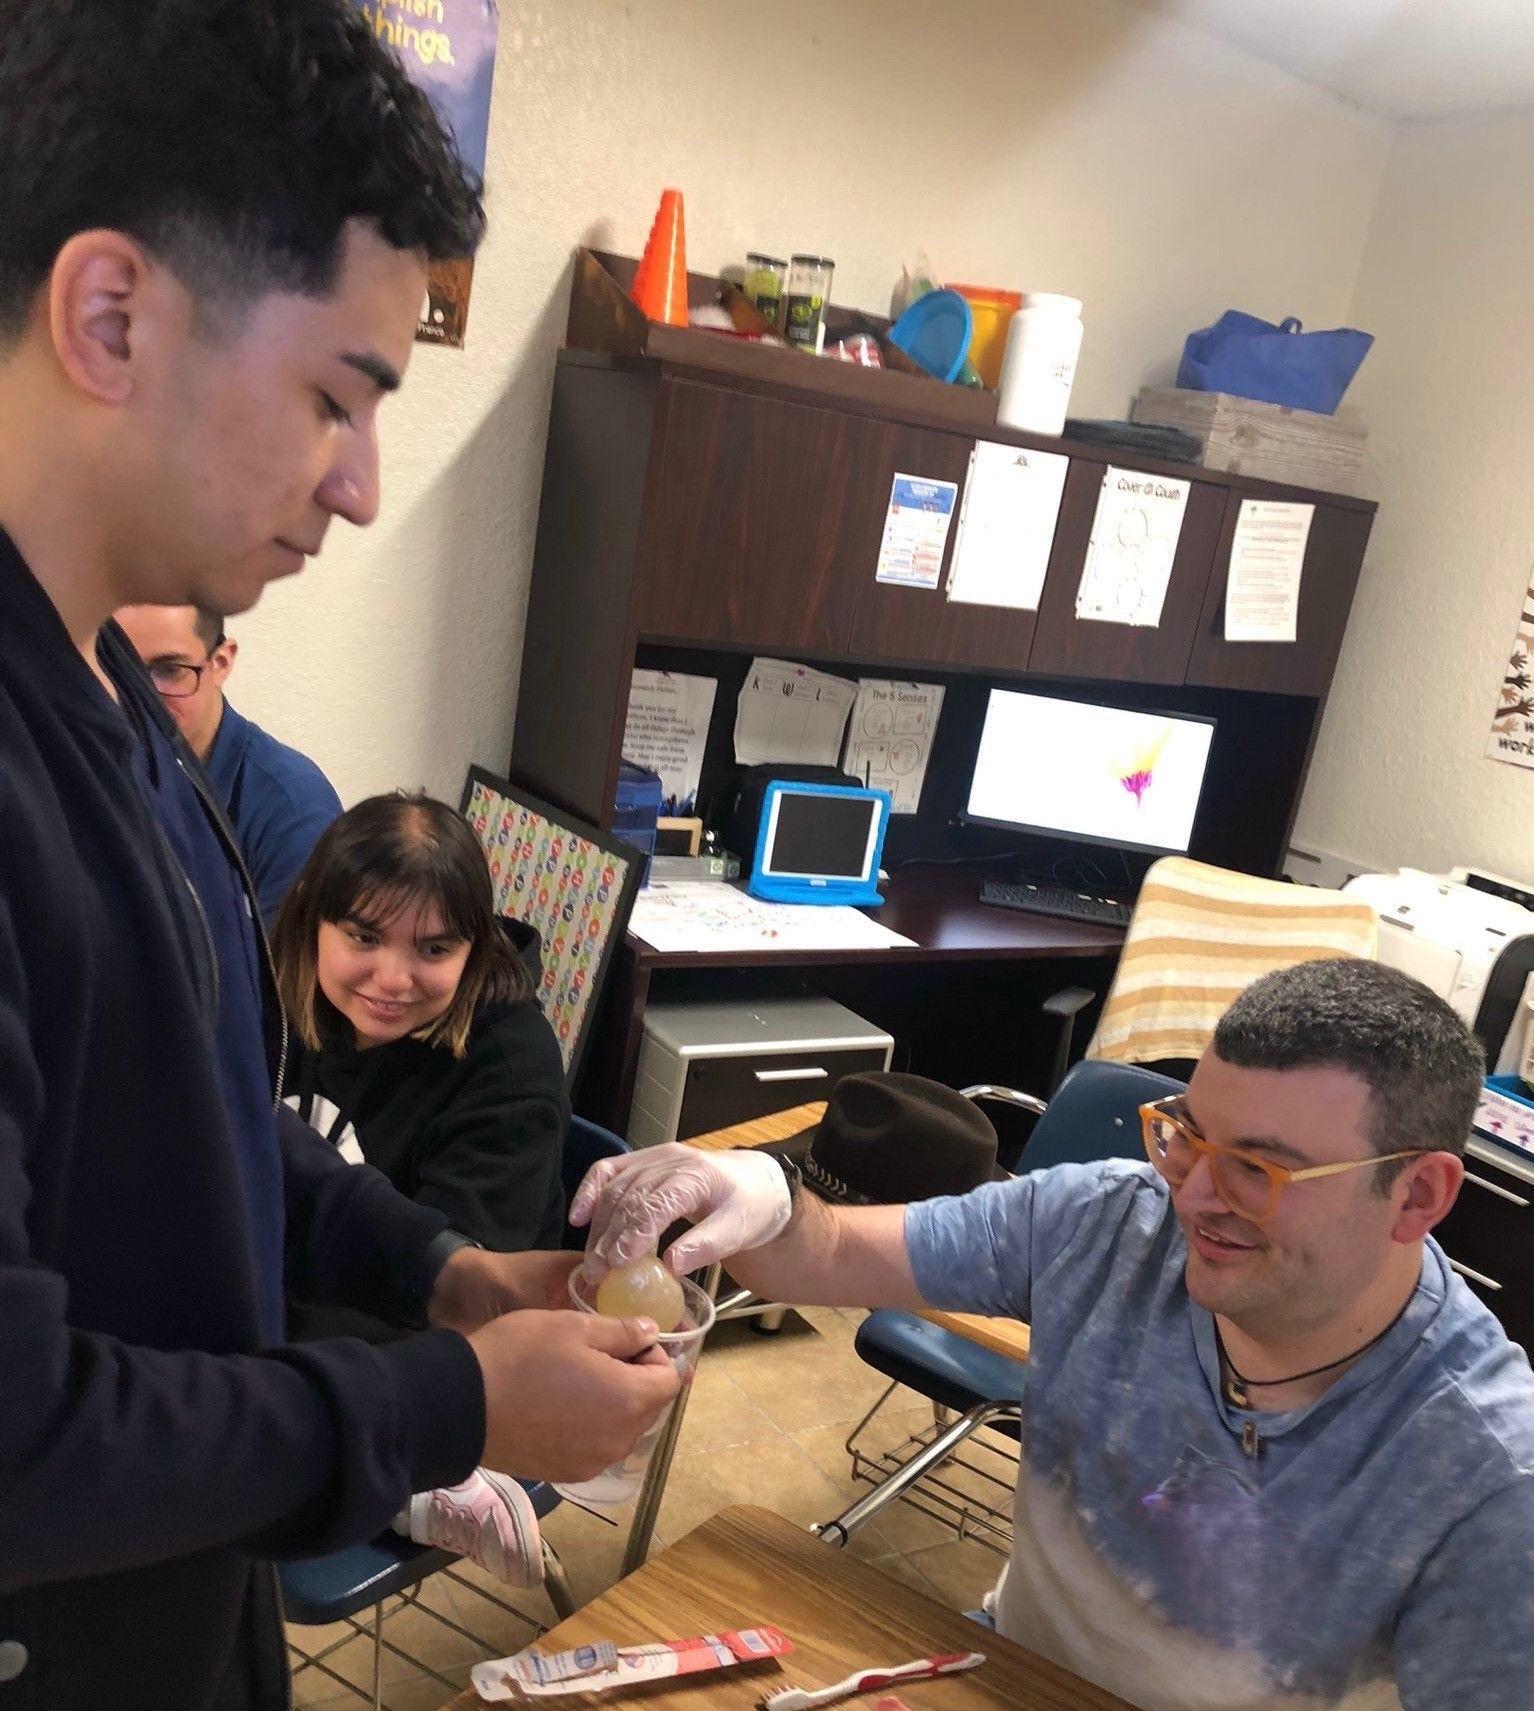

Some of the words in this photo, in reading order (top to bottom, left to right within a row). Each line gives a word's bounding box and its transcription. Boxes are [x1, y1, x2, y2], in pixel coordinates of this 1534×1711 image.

[872, 689, 887, 700] The
[889, 691, 895, 699] 5
[897, 692, 928, 703] Senses
